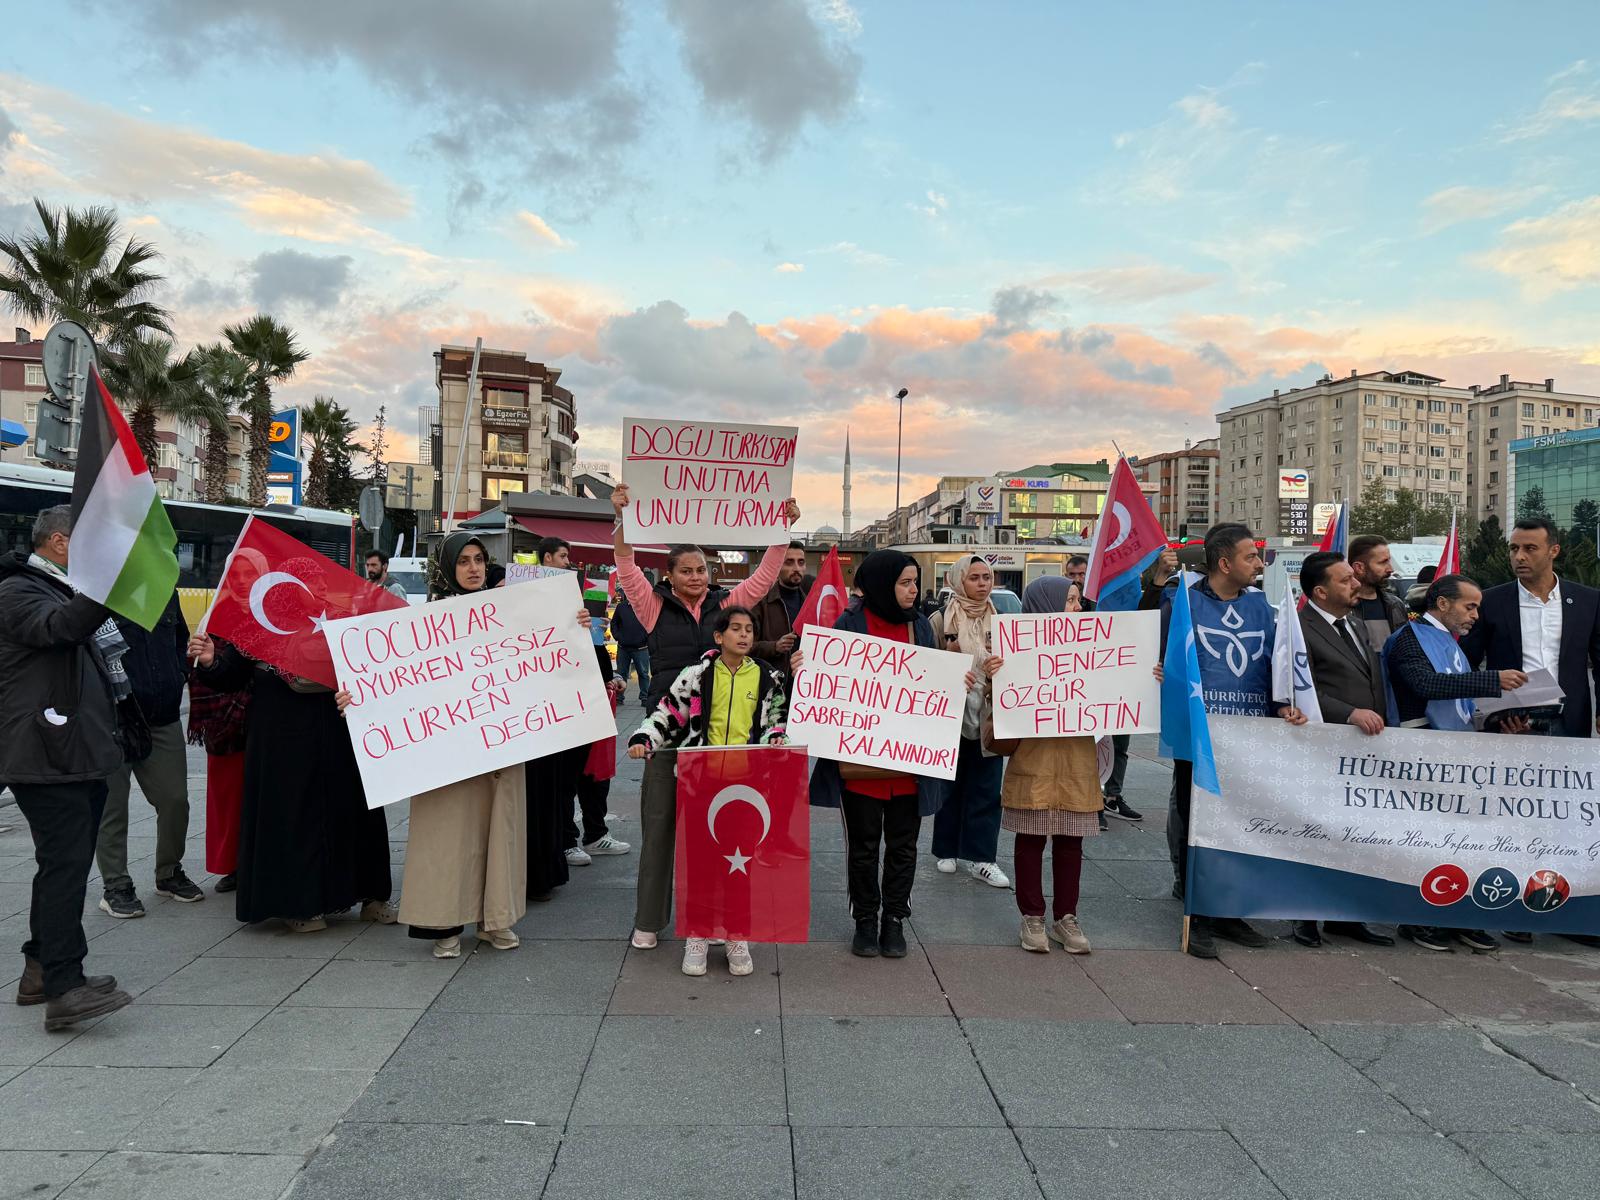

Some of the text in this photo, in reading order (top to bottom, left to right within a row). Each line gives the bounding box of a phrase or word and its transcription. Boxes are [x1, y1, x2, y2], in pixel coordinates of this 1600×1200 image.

[496, 409, 528, 419] EgzerFix
[631, 425, 797, 465] DOĞU TÜRKİSTAN
[1534, 435, 1556, 448] FSM
[663, 464, 770, 494] UNUTMA
[340, 602, 504, 673] ÇOCUKLAR
[999, 615, 1113, 659] NEHİRDEN
[343, 626, 565, 707] UYURKEN SESSİZ
[471, 647, 581, 693] OLUNUR,
[1038, 645, 1137, 681] DENİZE
[796, 669, 957, 720] GİDENİN DEĞİL
[1000, 678, 1088, 710] ÖZGÜR
[362, 687, 511, 760] ÖLÜRKEN
[791, 702, 881, 731] SABREDİP
[1035, 696, 1141, 735] FİLİSTİN
[838, 731, 957, 772] KALANINDIR!
[1337, 753, 1595, 791] HÜRRİYETÇİ EĞİTİM
[1344, 781, 1470, 815] İSTANBUL
[1479, 796, 1488, 816] 1
[1498, 796, 1570, 820] NOLU
[1244, 817, 1292, 836] Fikri
[1292, 823, 1331, 842] Hür,
[1341, 826, 1393, 846] Vicdanı
[1434, 828, 1485, 856] İrfanı
[1488, 835, 1522, 853] Hür
[1526, 837, 1580, 860] Eğitim
